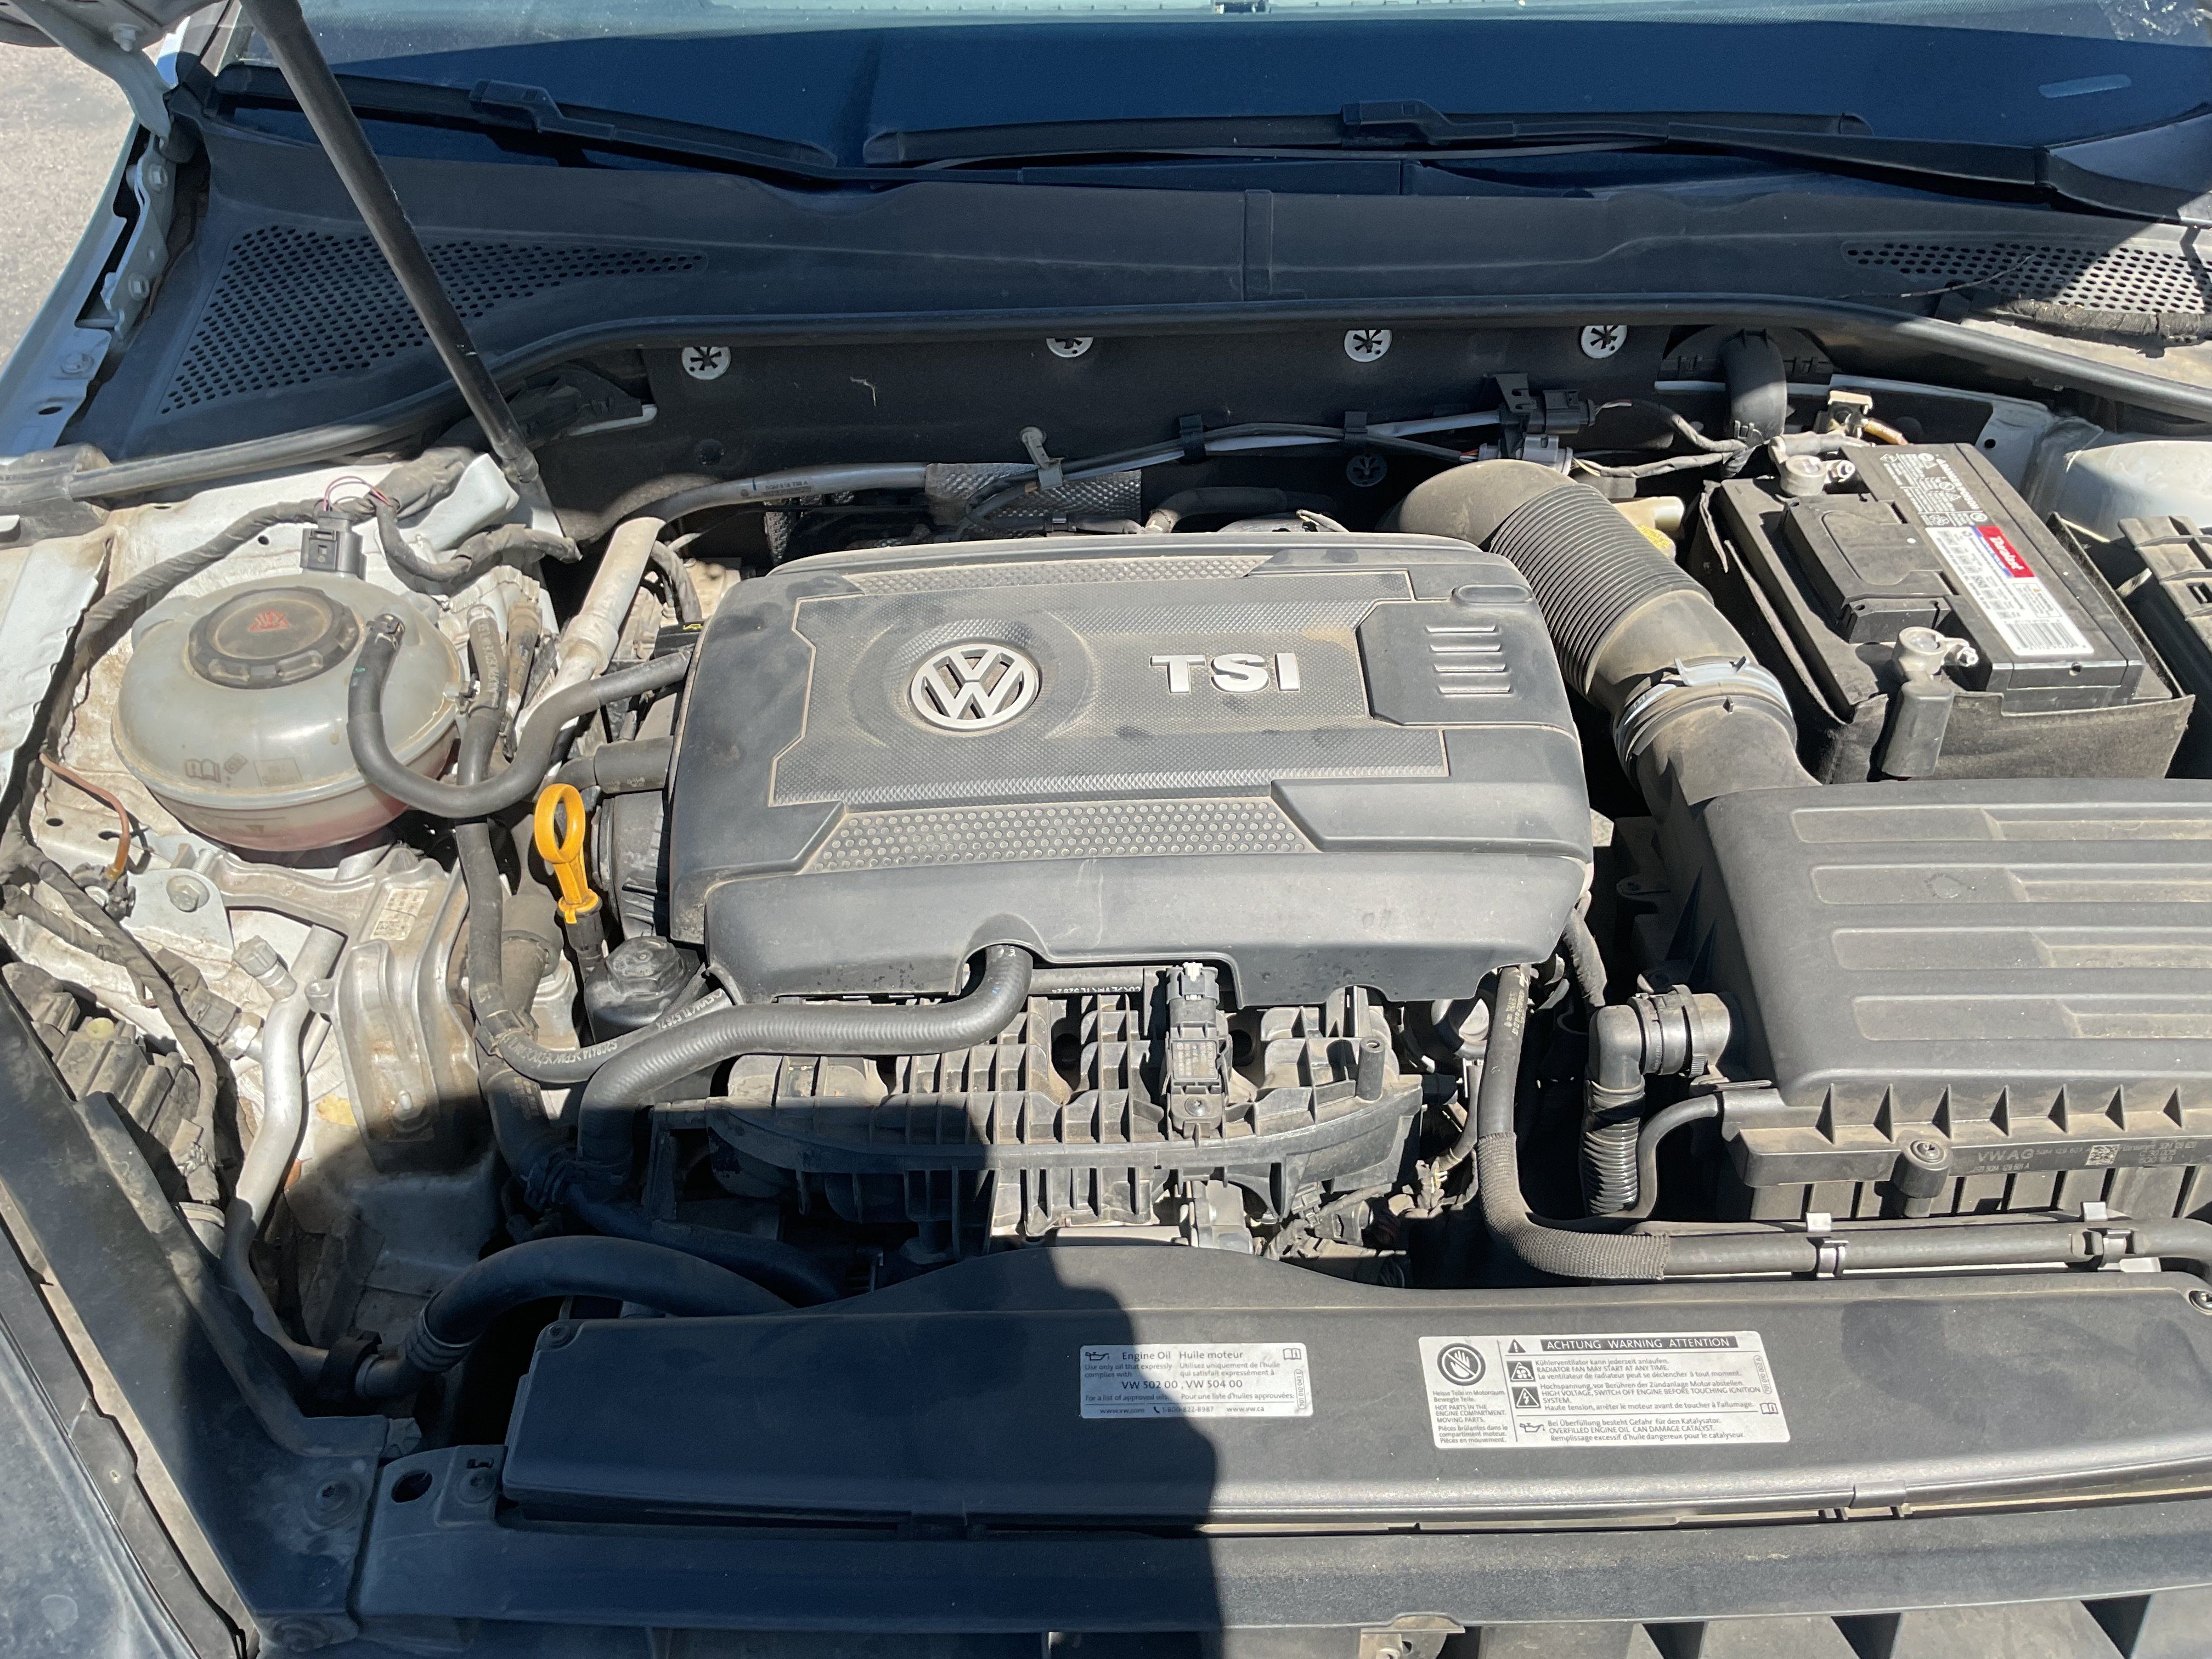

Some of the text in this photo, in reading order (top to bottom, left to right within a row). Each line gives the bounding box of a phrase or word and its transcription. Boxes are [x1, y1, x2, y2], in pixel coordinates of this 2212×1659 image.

[1989, 536, 2024, 569] Duralast
[1150, 652, 1301, 693] TSI
[911, 644, 1039, 731] VW
[1180, 1351, 1204, 1359] Huile
[1547, 1338, 1729, 1350] ACHTUNG WARNING ATTENTION
[1122, 1351, 1171, 1361] Engine Oil
